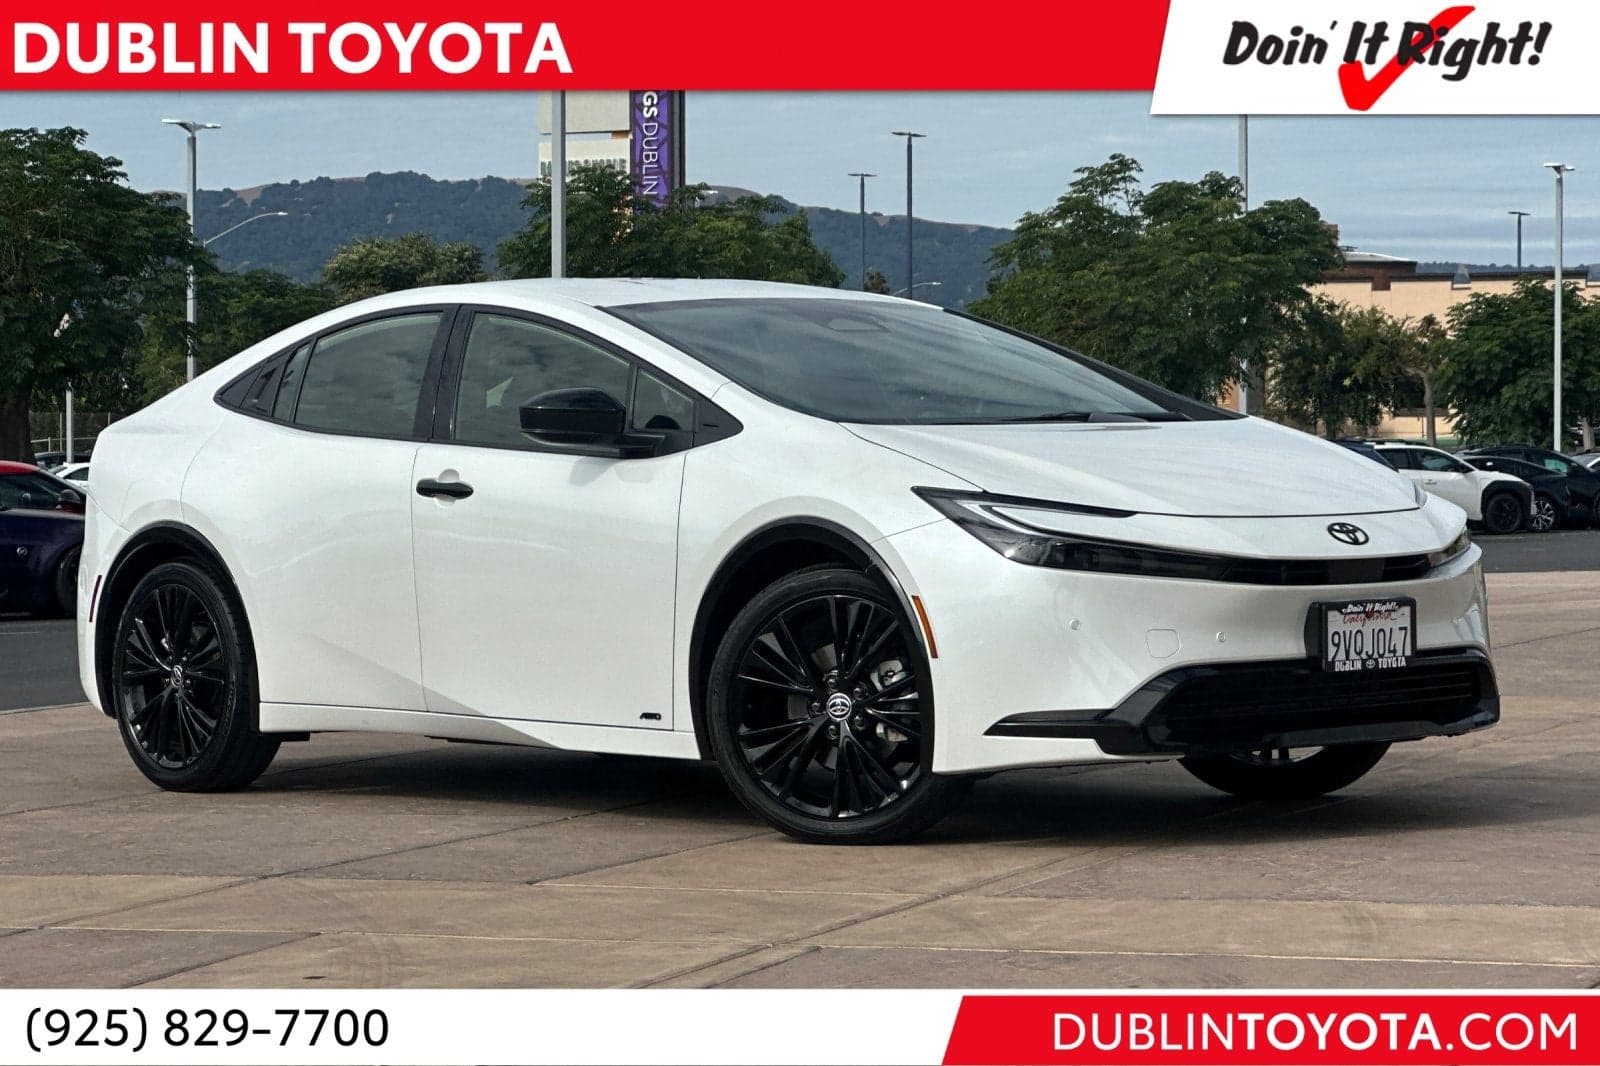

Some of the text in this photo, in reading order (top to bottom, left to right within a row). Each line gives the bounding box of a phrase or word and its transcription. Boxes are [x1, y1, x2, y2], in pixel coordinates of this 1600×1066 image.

[642, 122, 658, 195] DUBLIN
[1331, 626, 1408, 660] 9VQJ047
[1335, 656, 1407, 672] DUBLIN TOYOTA
